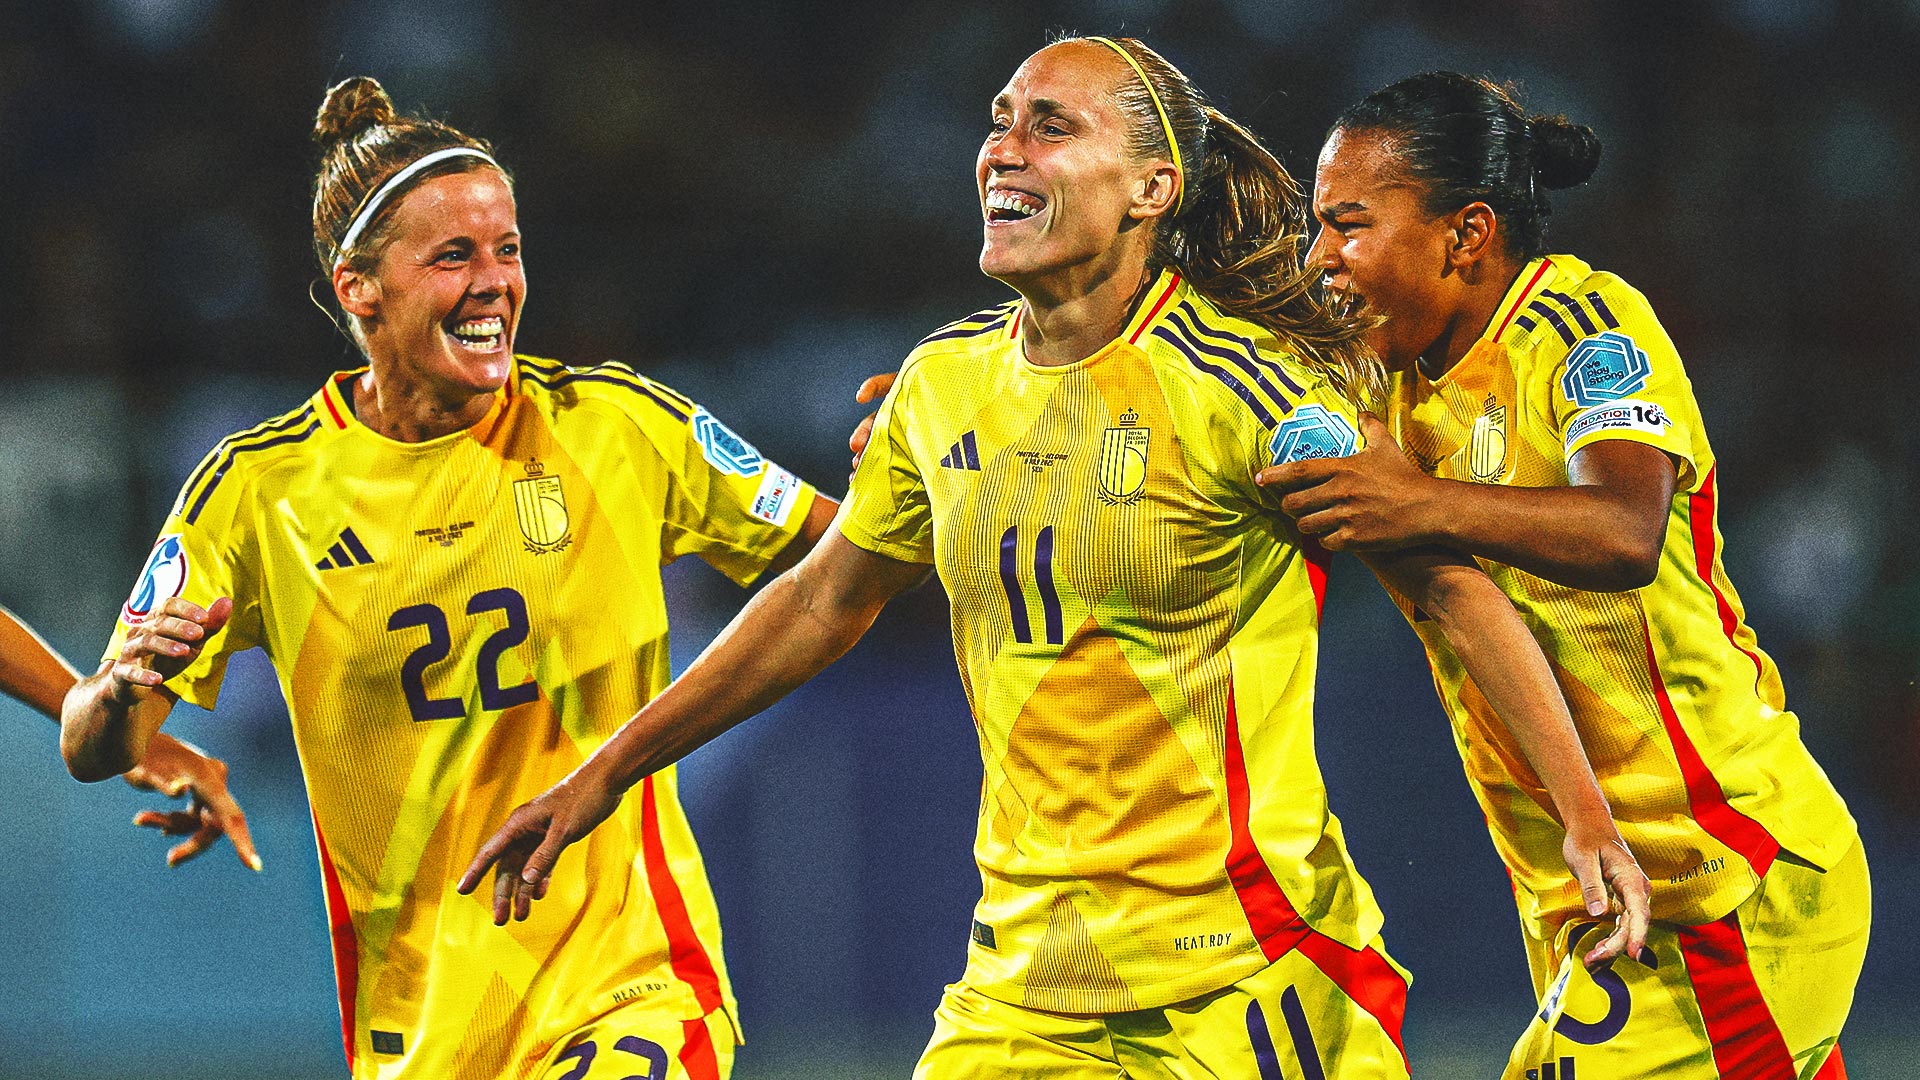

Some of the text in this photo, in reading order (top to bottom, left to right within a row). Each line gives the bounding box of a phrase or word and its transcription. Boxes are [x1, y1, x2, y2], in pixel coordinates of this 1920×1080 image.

[1587, 365, 1610, 379] play
[999, 525, 1064, 645] 11
[387, 587, 540, 723] 22
[1669, 856, 1725, 885] HEAT.RDY
[1174, 932, 1232, 951] HEAT.RDY
[1246, 984, 1326, 1080] 11
